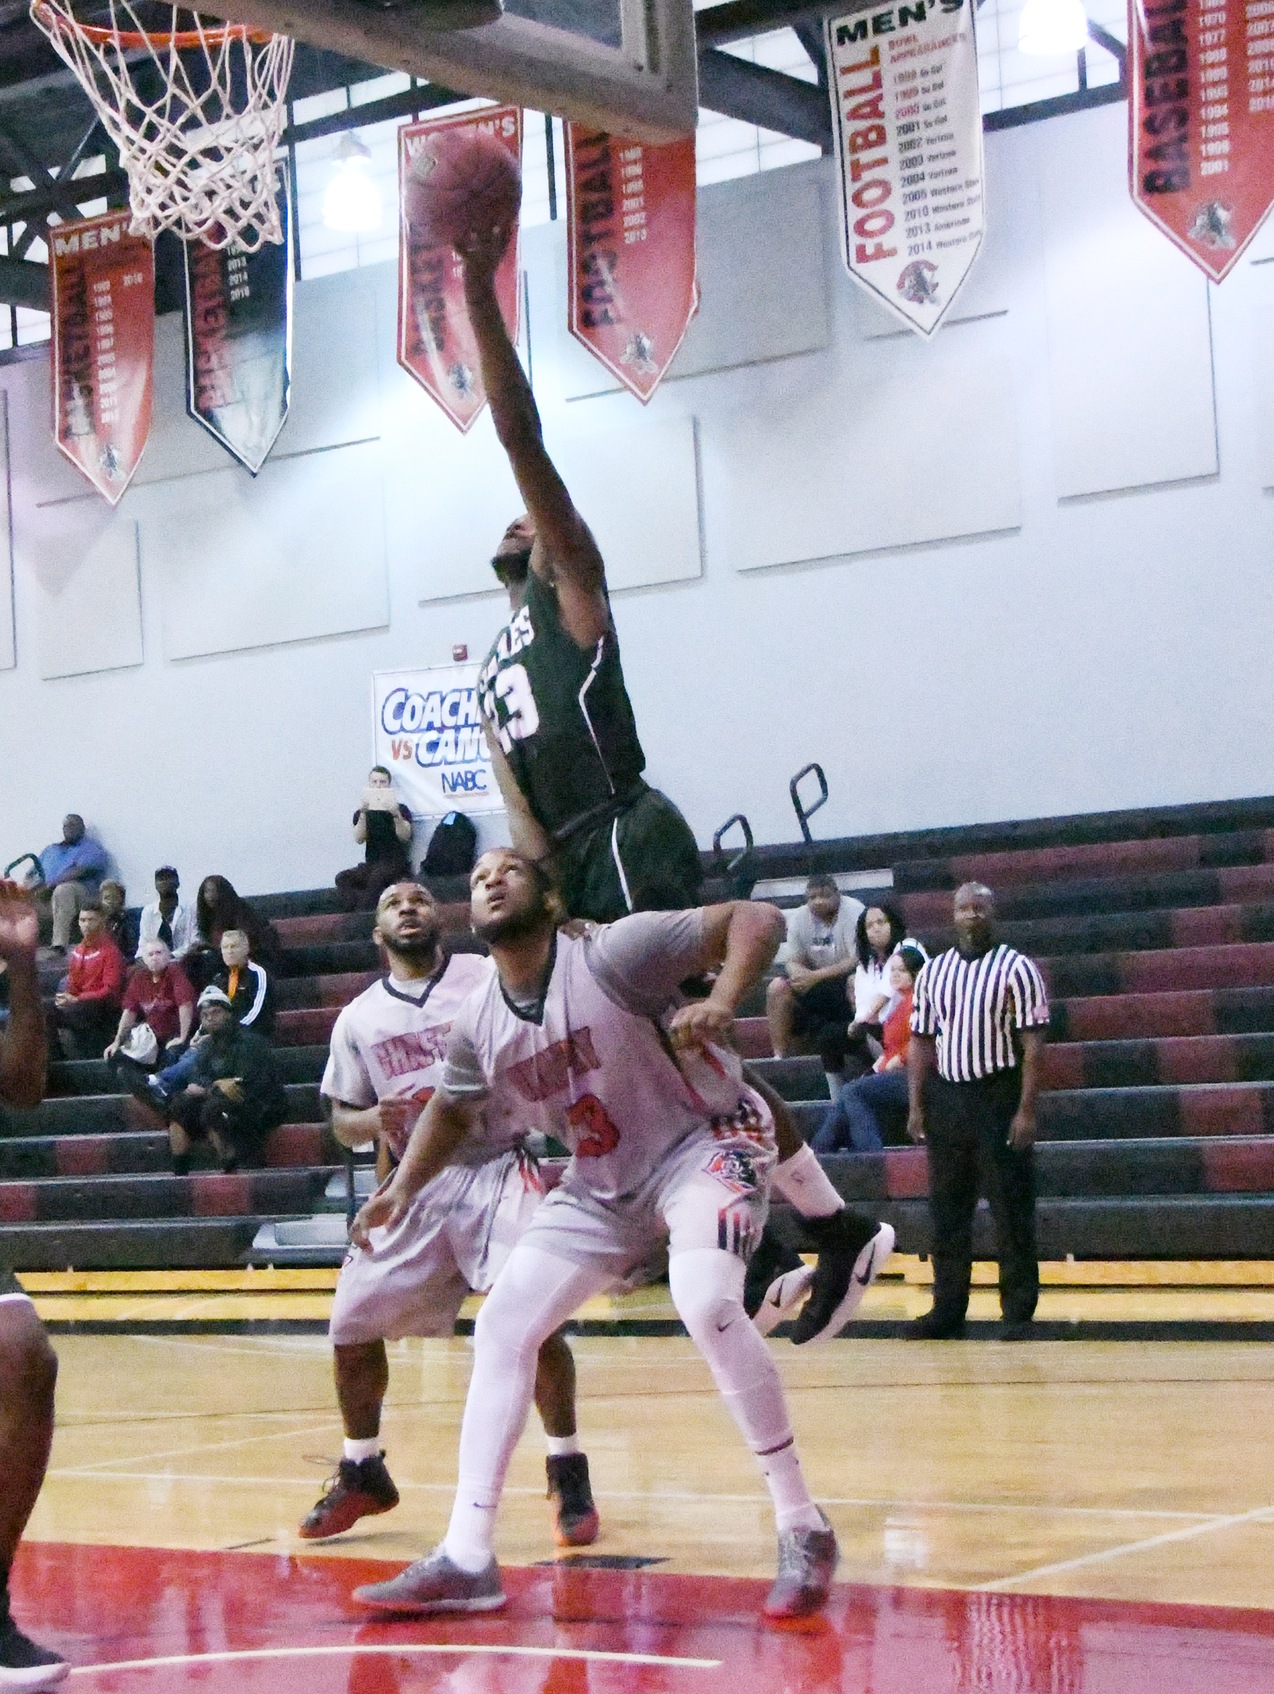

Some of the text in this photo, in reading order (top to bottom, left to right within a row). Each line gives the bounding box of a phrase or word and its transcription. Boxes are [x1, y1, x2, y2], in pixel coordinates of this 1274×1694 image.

[405, 116, 515, 158] WN'S
[840, 44, 898, 264] FOOTBALL
[901, 171, 925, 188] 2004
[904, 204, 929, 222] 2010
[55, 221, 134, 256] MEN'
[905, 222, 931, 239] 2013
[907, 240, 932, 257] 2014
[382, 687, 482, 735] COACH
[391, 738, 413, 761] VS
[441, 769, 487, 793] NABC
